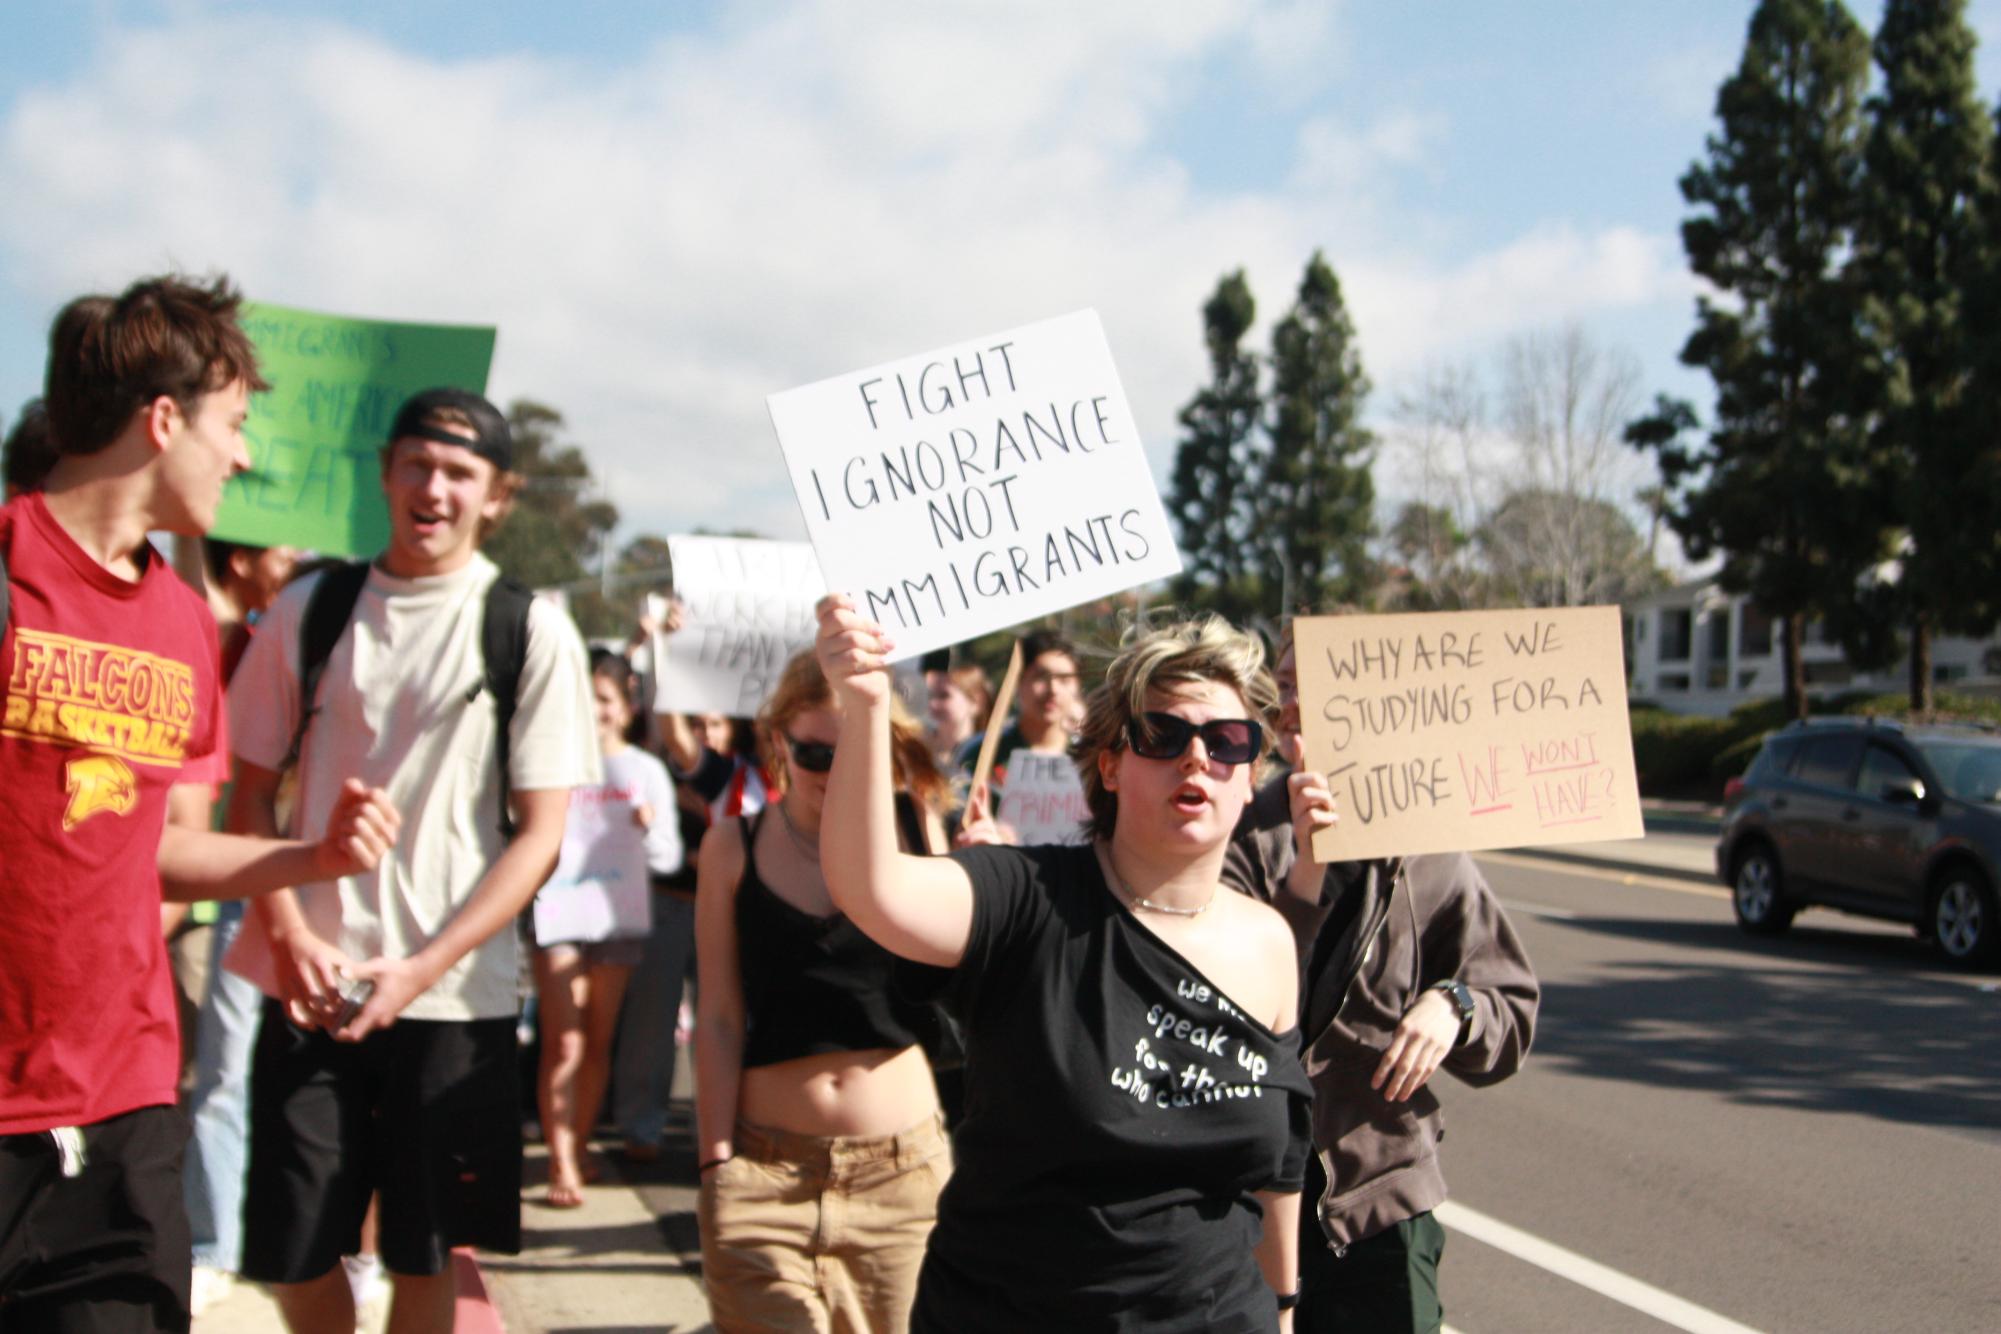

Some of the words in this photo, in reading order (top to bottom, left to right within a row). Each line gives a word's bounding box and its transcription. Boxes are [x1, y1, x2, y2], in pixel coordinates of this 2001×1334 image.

[858, 341, 1017, 429] FIGHT
[810, 395, 1120, 521] IGNORANCE
[927, 474, 1020, 550] NOT
[846, 508, 1150, 628] MMIGRANTS
[8, 635, 194, 730] FALCONS
[1326, 637, 1402, 681] WHY
[1412, 631, 1486, 673] ARE
[1504, 621, 1565, 656] WE
[1323, 683, 1472, 753] STUDYING
[1491, 677, 1569, 716] FOR
[1578, 677, 1603, 707] A
[1020, 755, 1069, 783] THE
[1457, 745, 1518, 807] WE
[1177, 979, 1212, 1003] we
[1146, 1003, 1229, 1057] speak
[1237, 1045, 1268, 1082] up
[1111, 1067, 1151, 1103] who
